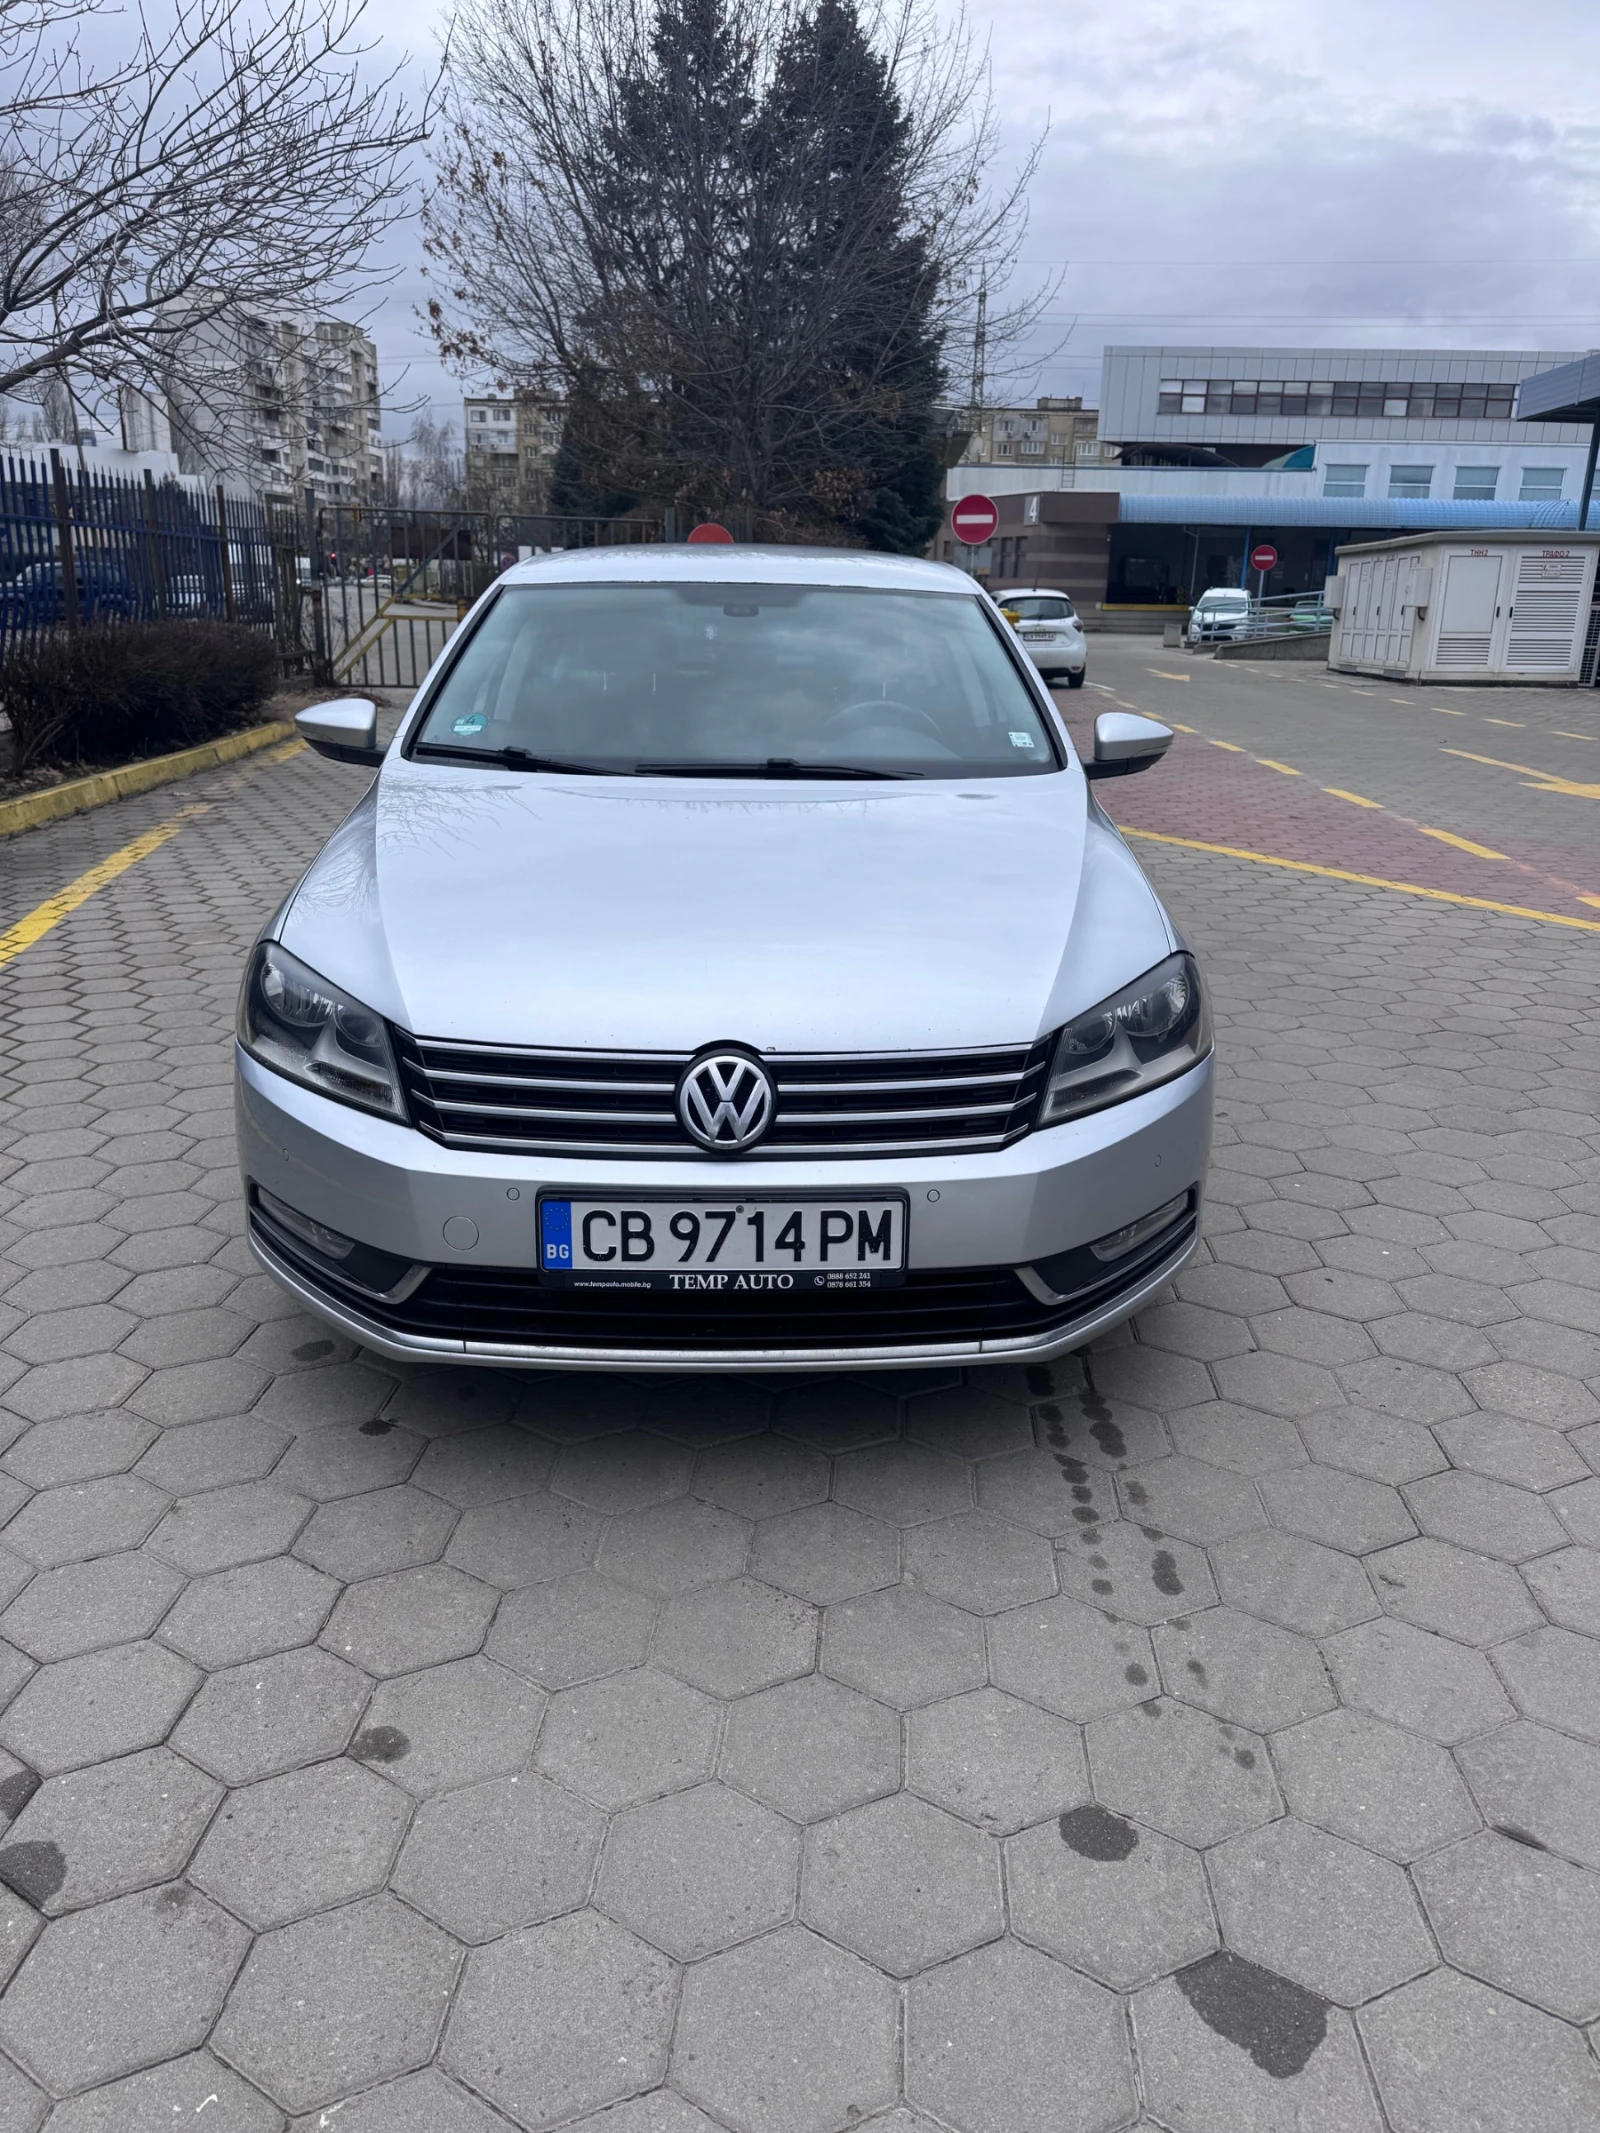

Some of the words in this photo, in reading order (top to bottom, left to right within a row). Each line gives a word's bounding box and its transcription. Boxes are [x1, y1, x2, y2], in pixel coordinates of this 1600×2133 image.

[1029, 497, 1037, 522] 4
[682, 1058, 770, 1143] VW
[582, 1209, 656, 1262] CB
[669, 1210, 806, 1263] 9714
[819, 1209, 892, 1262] PM
[546, 1243, 570, 1259] BG
[669, 1274, 729, 1290] TEMP
[733, 1274, 794, 1290] AUTO
[827, 1272, 844, 1280] 0888
[844, 1272, 857, 1280] 652
[827, 1280, 844, 1288] 0878
[844, 1280, 857, 1288] 661
[858, 1280, 871, 1288] 354
[573, 1280, 652, 1290] www.tempauto.mobile.bg
